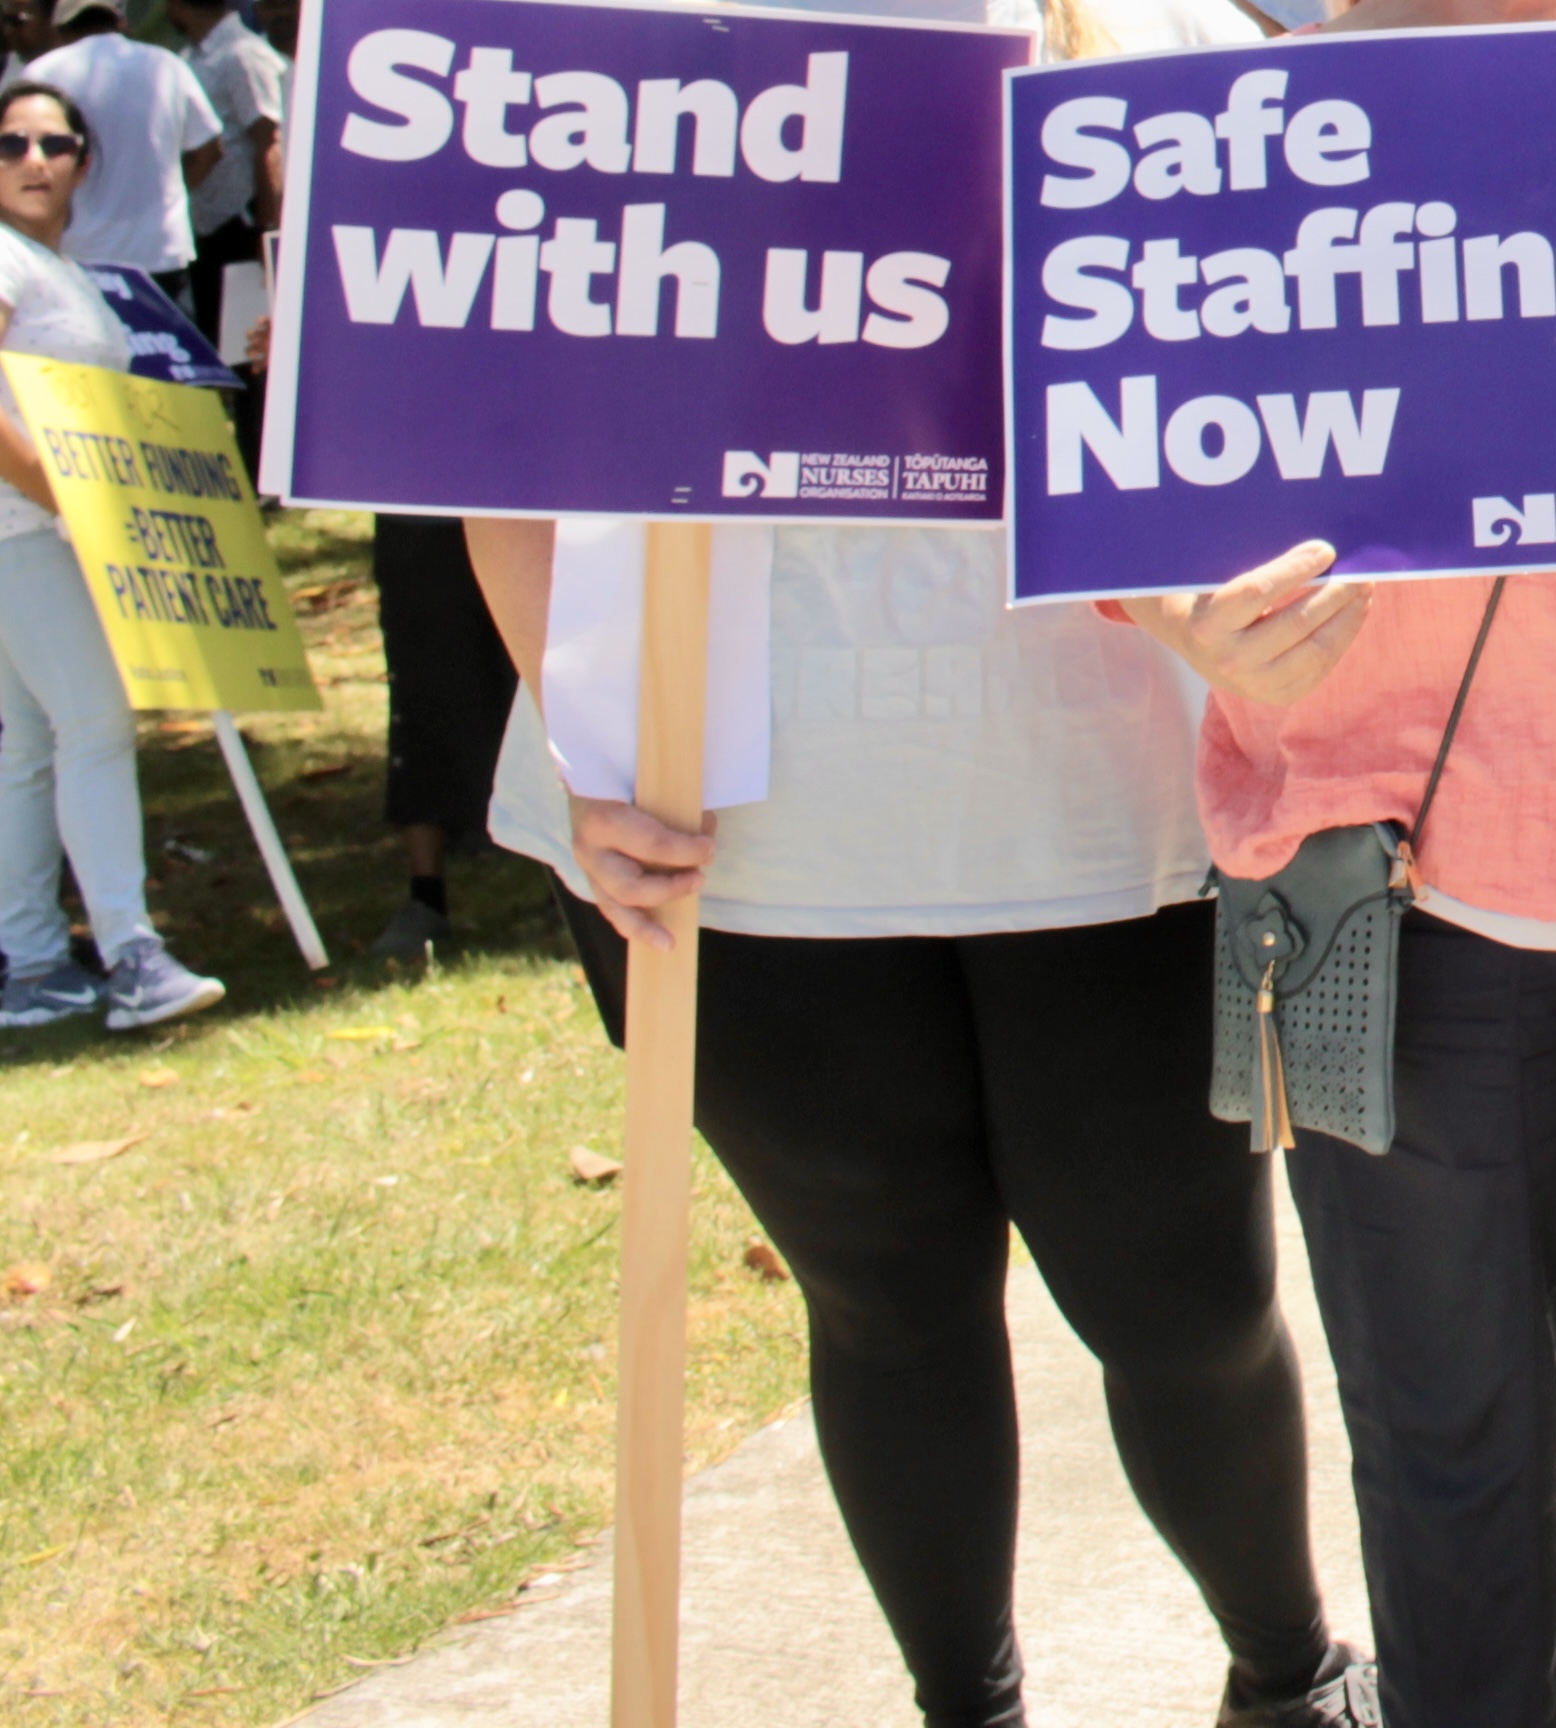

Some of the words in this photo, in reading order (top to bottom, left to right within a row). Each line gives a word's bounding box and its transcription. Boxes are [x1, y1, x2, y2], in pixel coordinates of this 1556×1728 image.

[341, 28, 849, 183] Stand
[1040, 68, 1372, 209] Safe
[332, 188, 721, 338] with
[763, 247, 951, 349] us
[44, 428, 144, 488] BETTER
[140, 441, 243, 502] FUNDING
[801, 453, 832, 466] NEW
[832, 454, 889, 467] ZEALAND
[1046, 375, 1401, 497] Now
[800, 467, 889, 486] NURSES
[800, 486, 888, 500] ORGANISATION
[902, 472, 987, 490] TAPUHI
[106, 564, 209, 626] PATIENT
[205, 574, 277, 631] CARE
